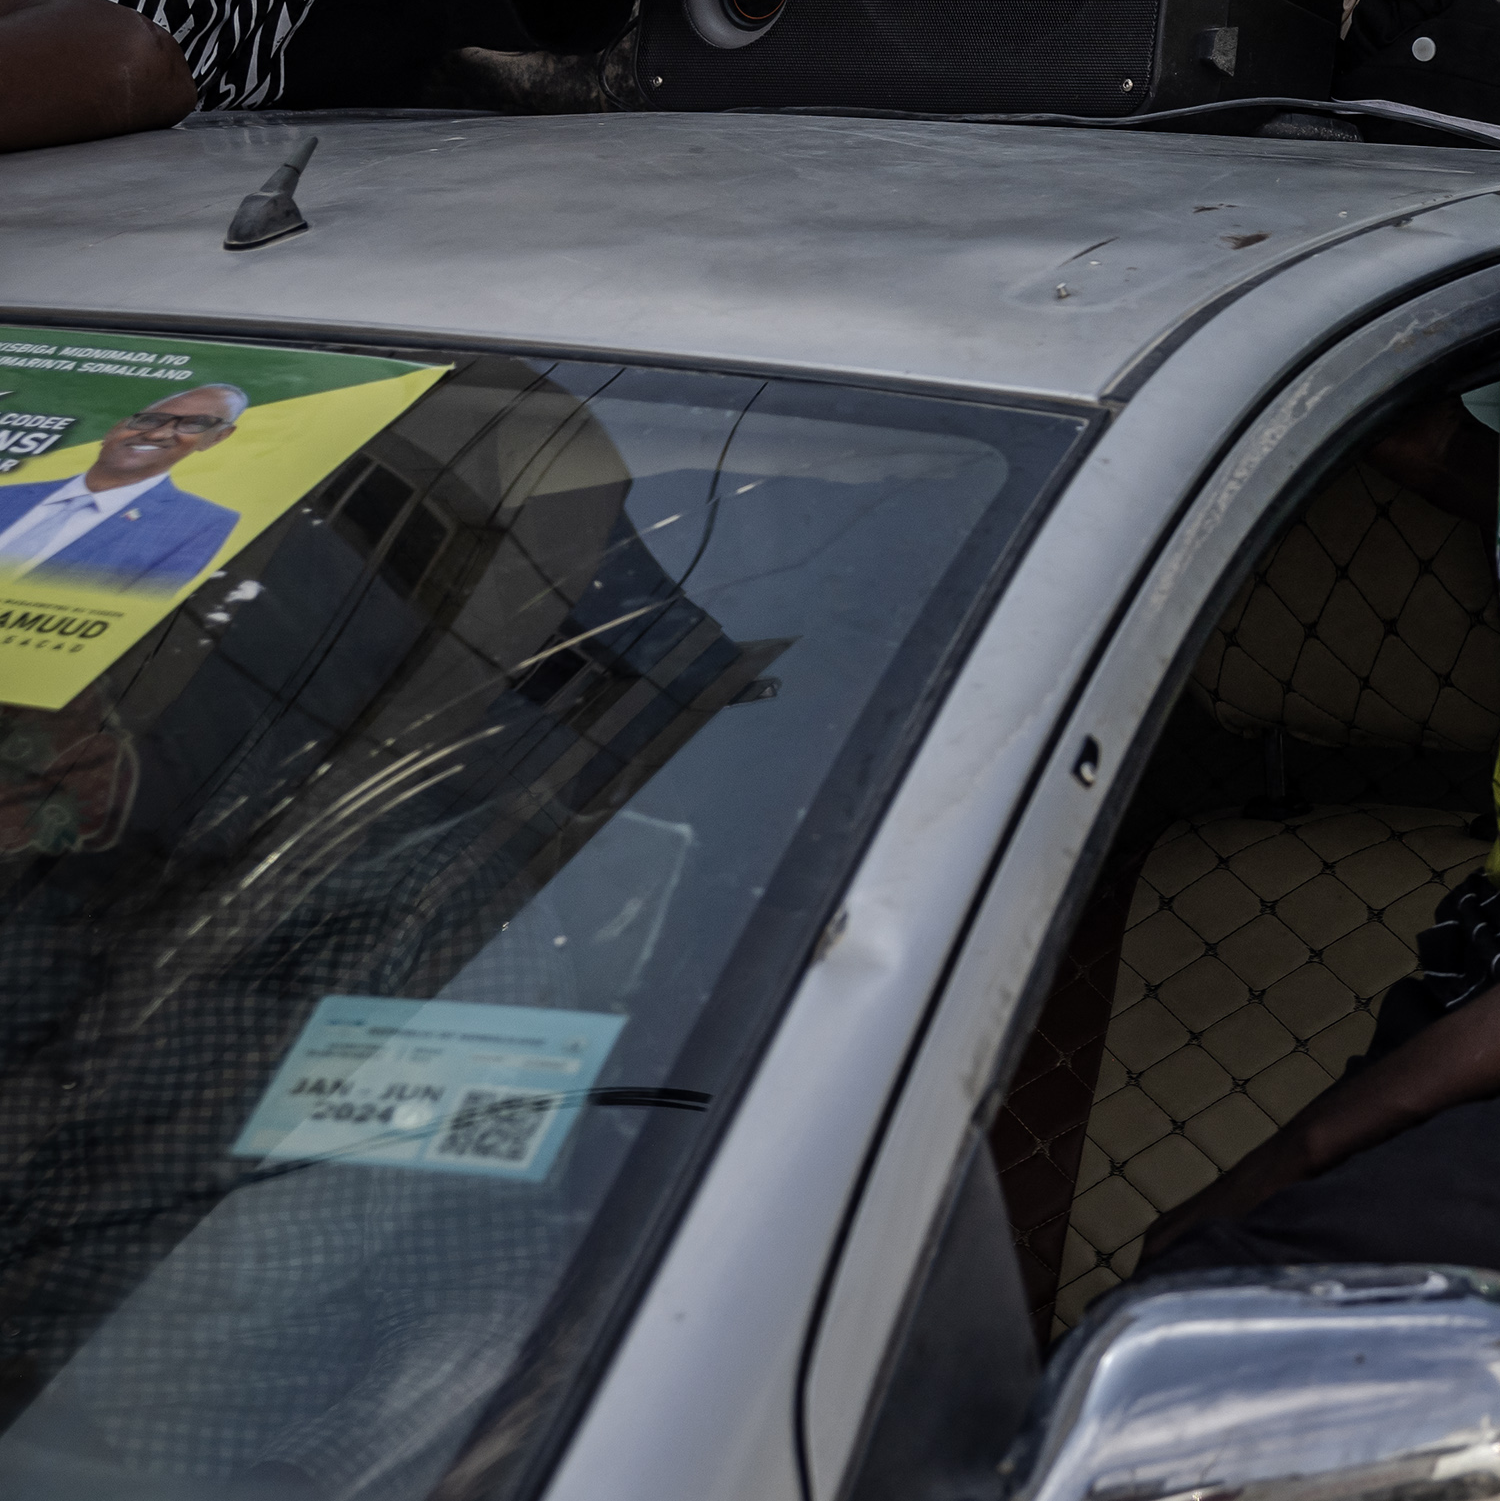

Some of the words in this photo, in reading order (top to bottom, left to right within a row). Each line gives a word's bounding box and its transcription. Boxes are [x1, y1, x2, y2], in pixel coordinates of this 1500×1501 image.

[58, 347, 158, 364] MIDNIMADA
[158, 354, 191, 366] IYO
[77, 362, 194, 381] SOMALILAND
[290, 1077, 354, 1097] JAN
[381, 1082, 446, 1102] JUN
